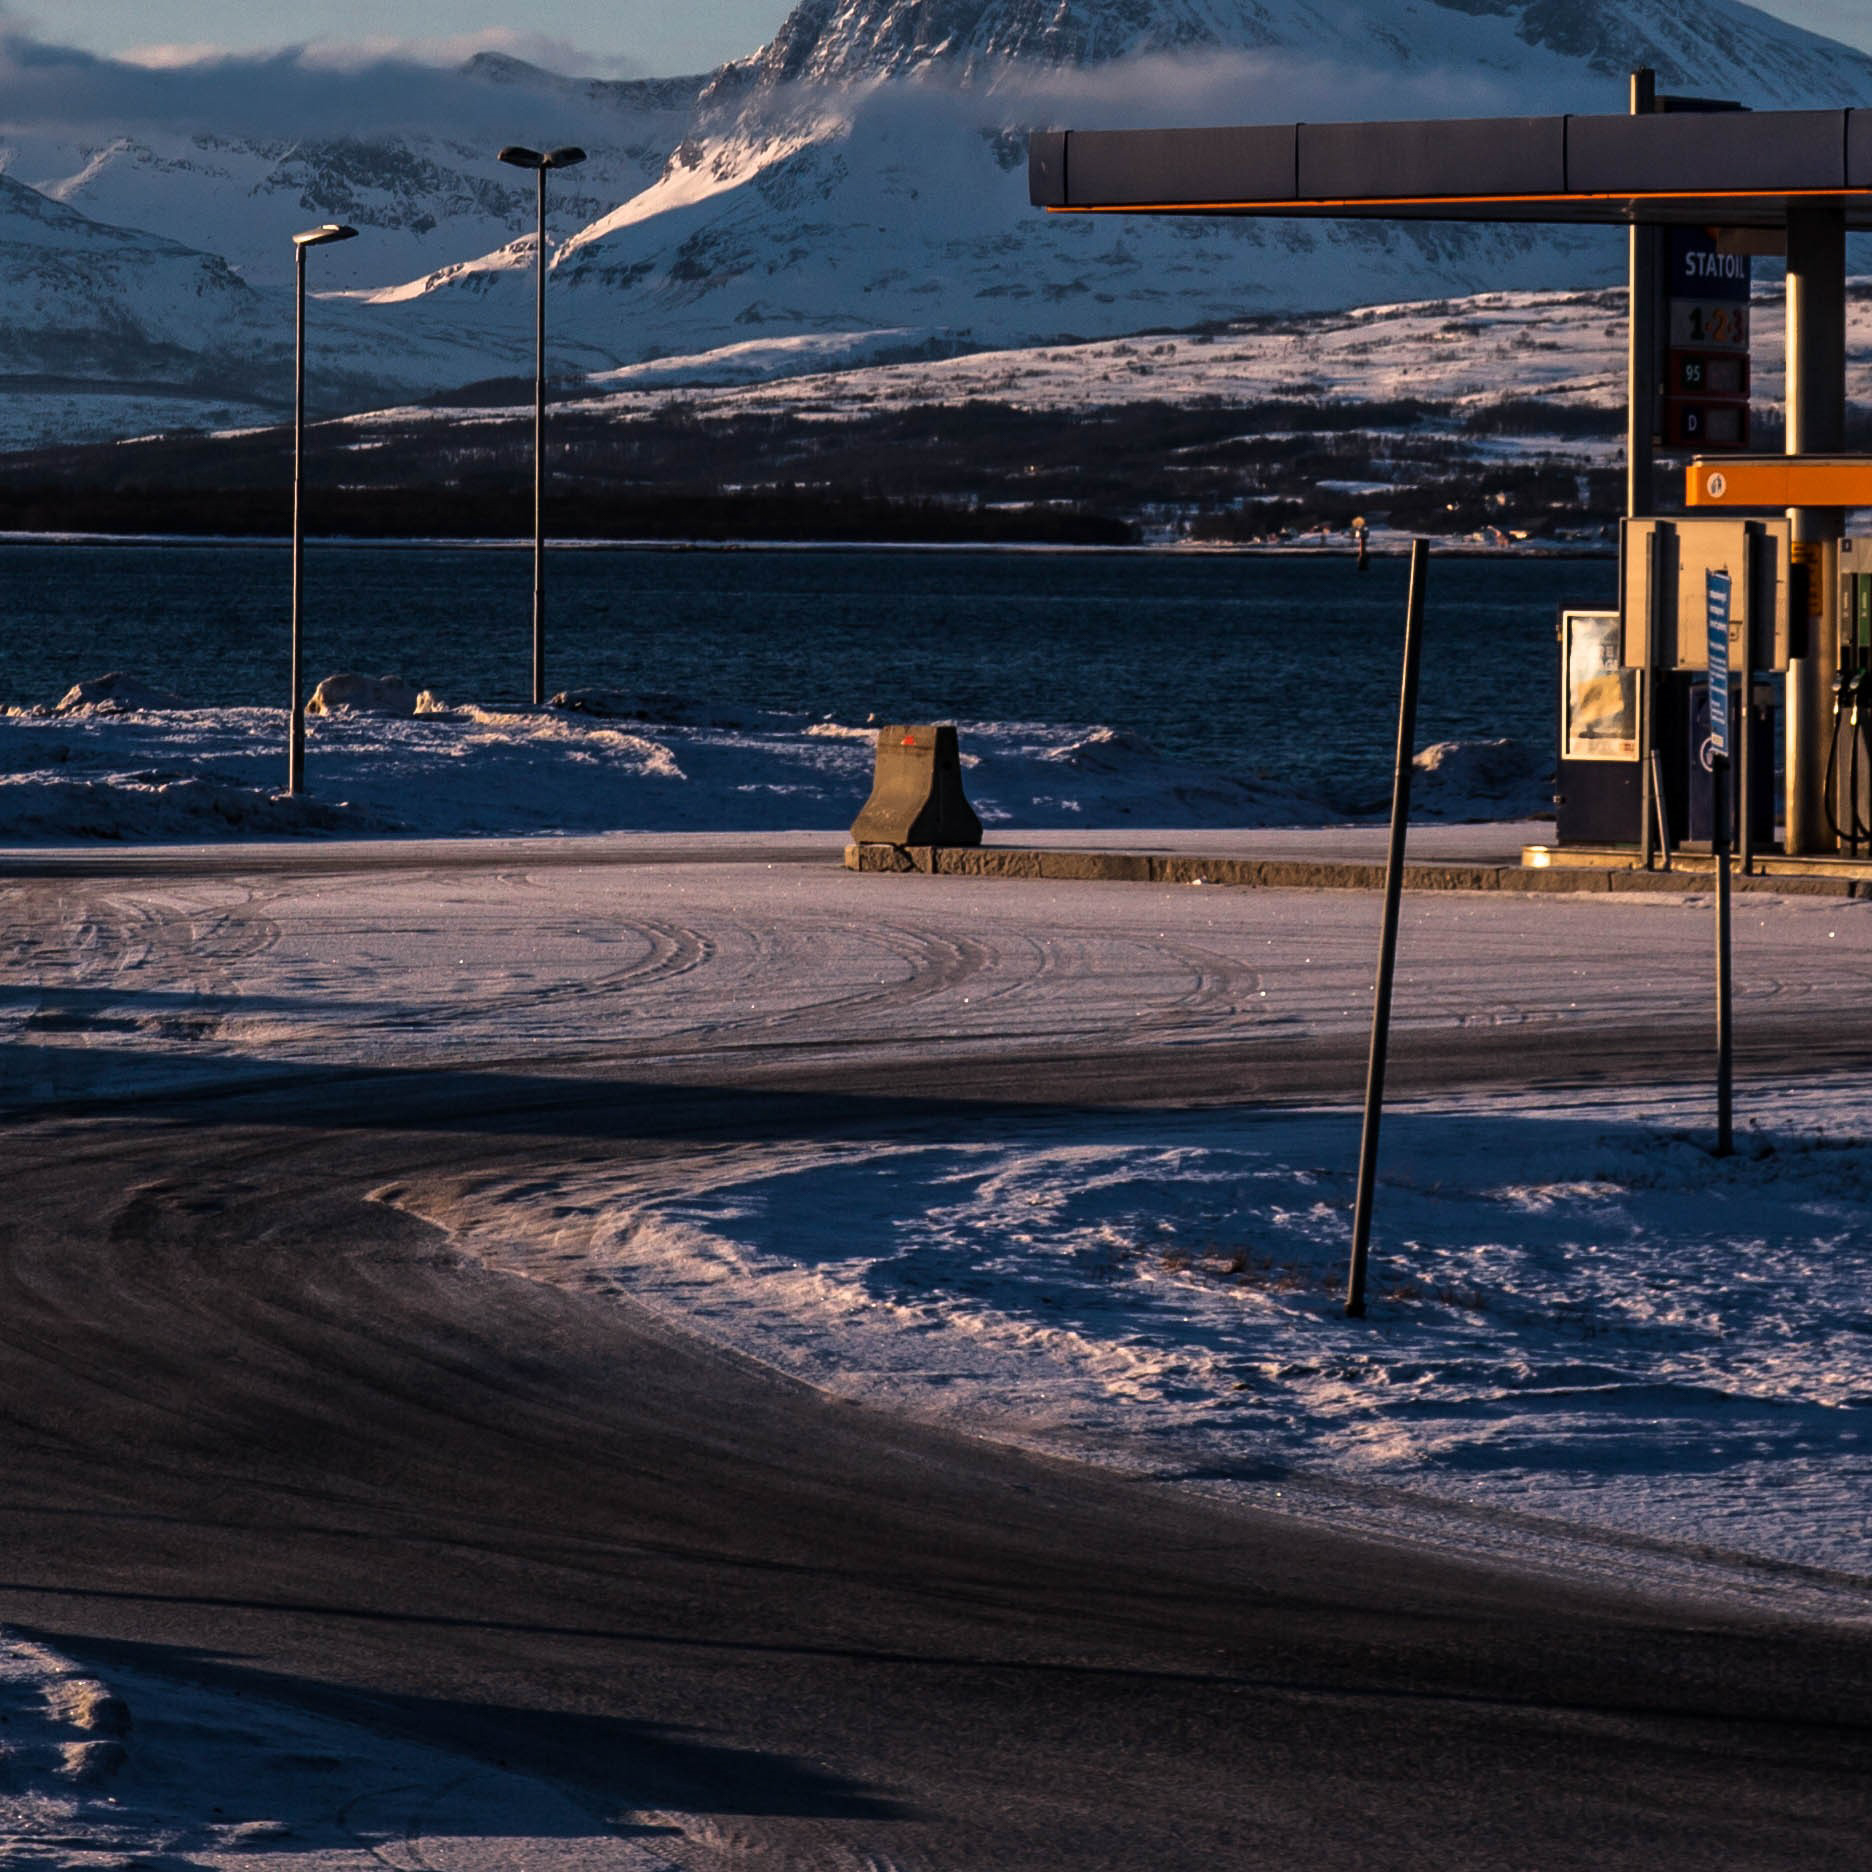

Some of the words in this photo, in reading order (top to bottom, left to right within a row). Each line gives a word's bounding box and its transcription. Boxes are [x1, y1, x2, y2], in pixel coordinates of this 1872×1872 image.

[1684, 250, 1745, 279] STATOIL
[1685, 363, 1701, 383] 95
[1688, 414, 1697, 430] D
